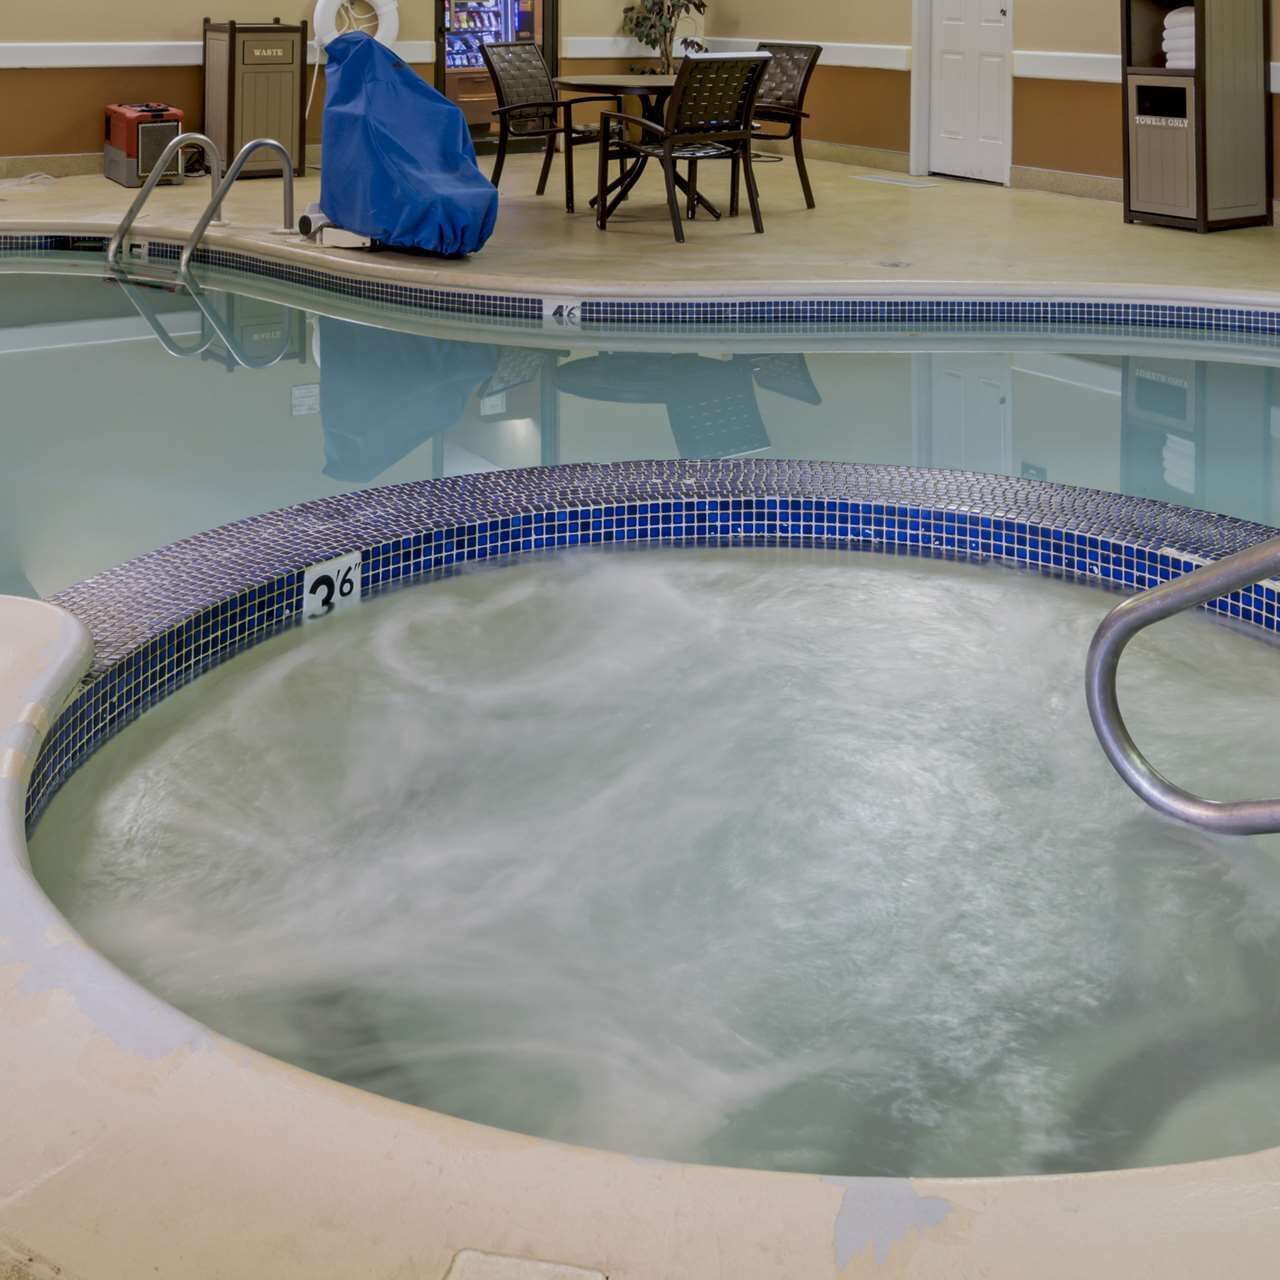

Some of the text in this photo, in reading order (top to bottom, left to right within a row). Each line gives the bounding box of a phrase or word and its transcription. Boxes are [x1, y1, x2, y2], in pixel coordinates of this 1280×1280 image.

[254, 48, 283, 56] WASTE
[1135, 116, 1189, 127] TOWELS ONLY
